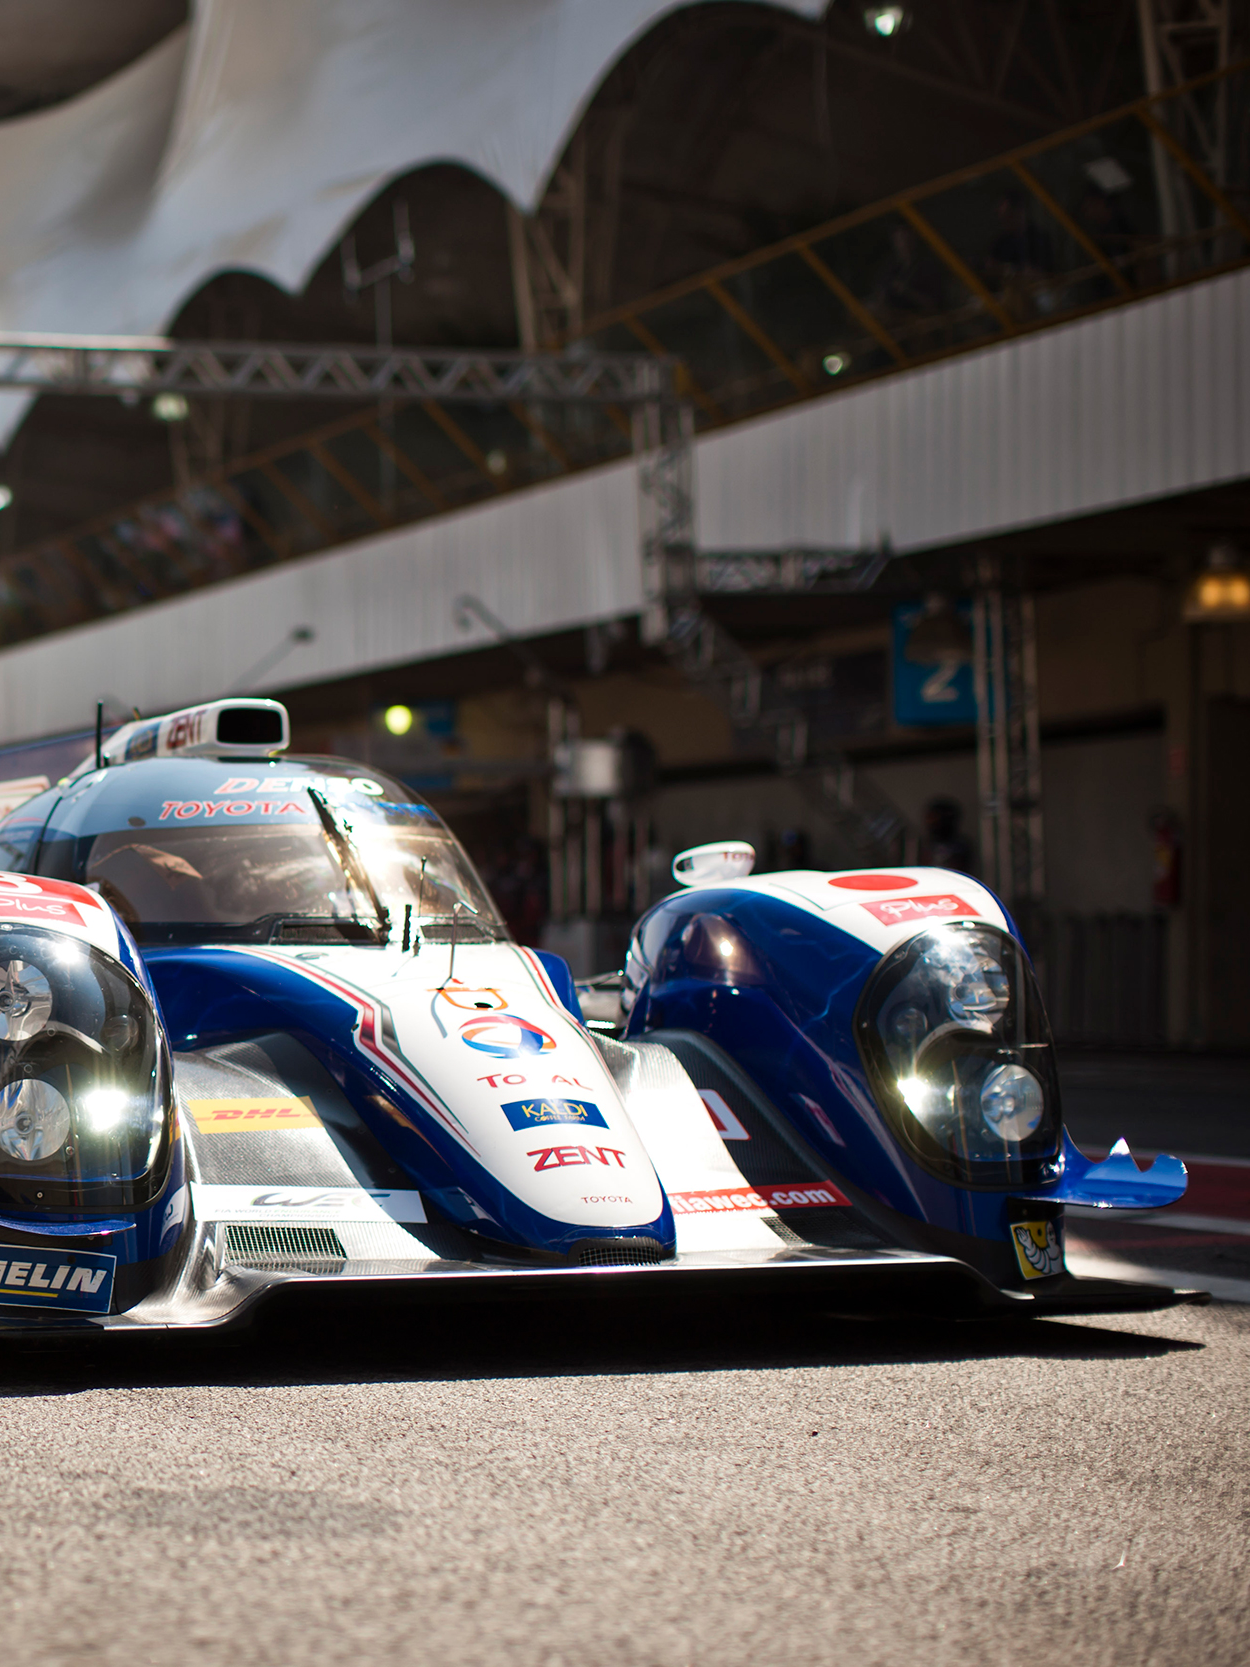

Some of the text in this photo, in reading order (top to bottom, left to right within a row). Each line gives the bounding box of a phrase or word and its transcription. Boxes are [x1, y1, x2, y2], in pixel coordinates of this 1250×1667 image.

[166, 709, 207, 750] ZENT
[213, 776, 385, 796] DENSO
[159, 800, 306, 820] TOYOTA
[879, 898, 959, 915] Plus
[476, 1073, 594, 1091] TOAL
[211, 1108, 301, 1121] DHL
[521, 1102, 589, 1118] KALDI
[525, 1145, 626, 1172] ZENT
[580, 1195, 633, 1204] TOYOTA
